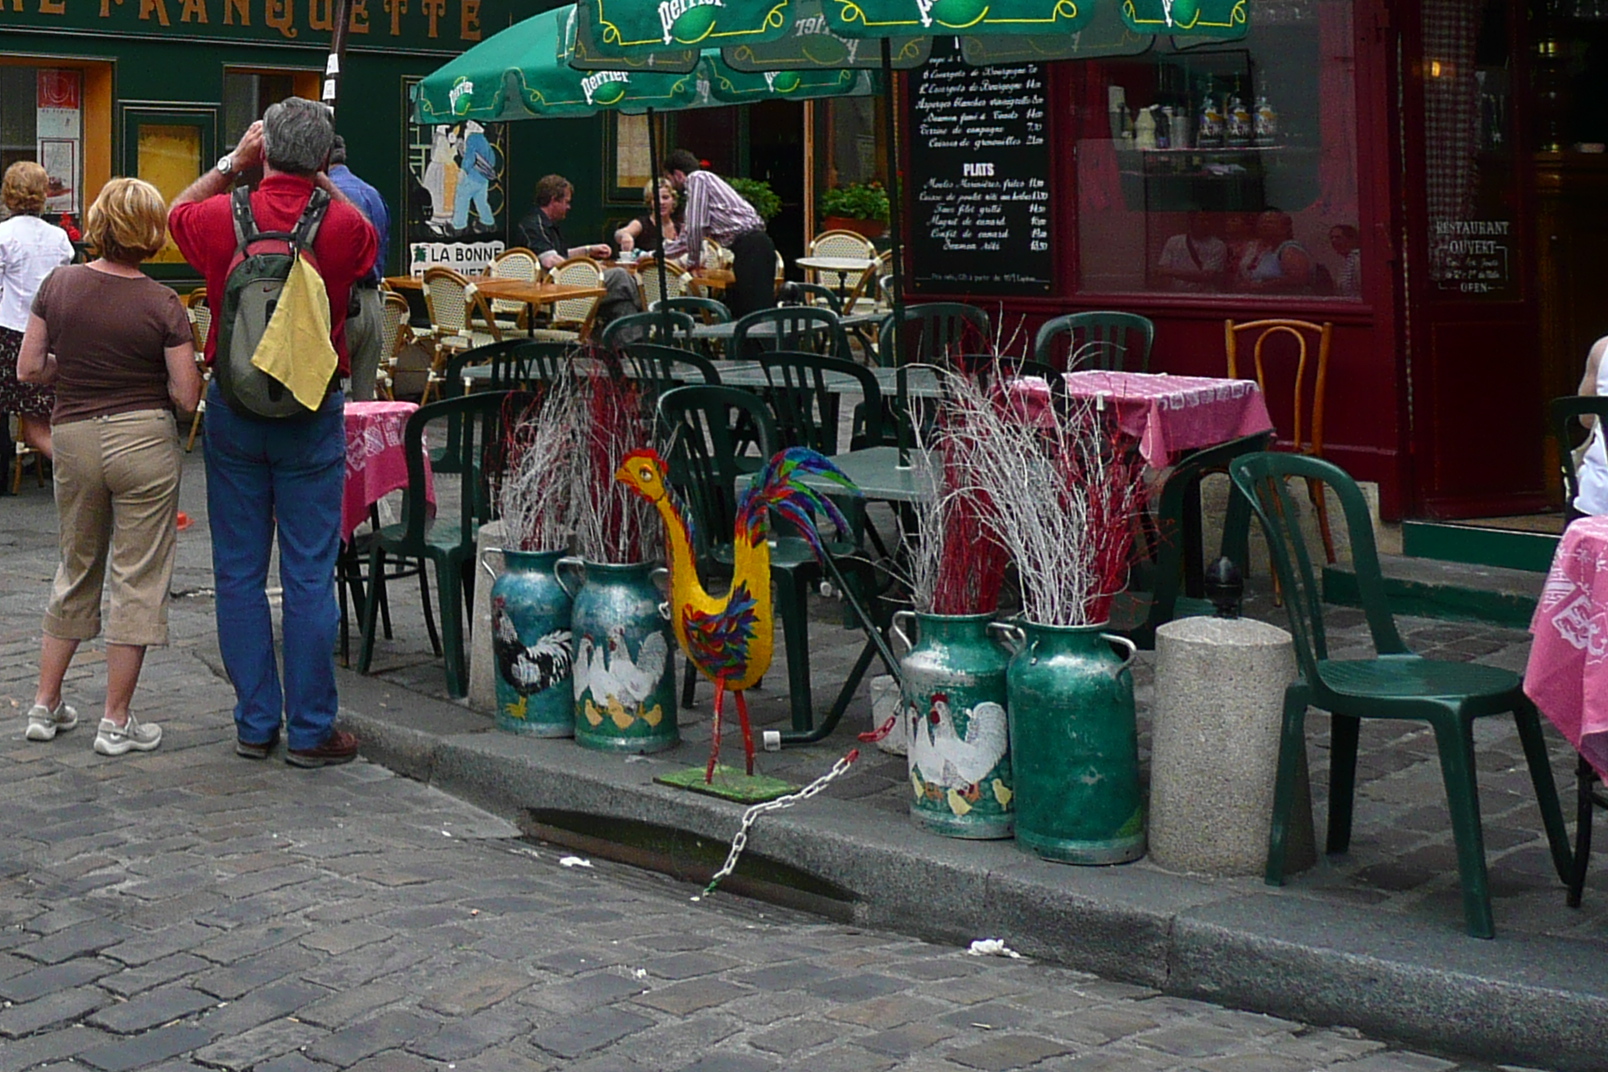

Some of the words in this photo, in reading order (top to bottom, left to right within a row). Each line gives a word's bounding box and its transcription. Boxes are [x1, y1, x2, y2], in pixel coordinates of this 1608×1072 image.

[963, 163, 995, 176] PLATS
[1436, 221, 1510, 235] RESTAURANT
[1450, 240, 1496, 254] OUVERT
[431, 248, 450, 262] LA
